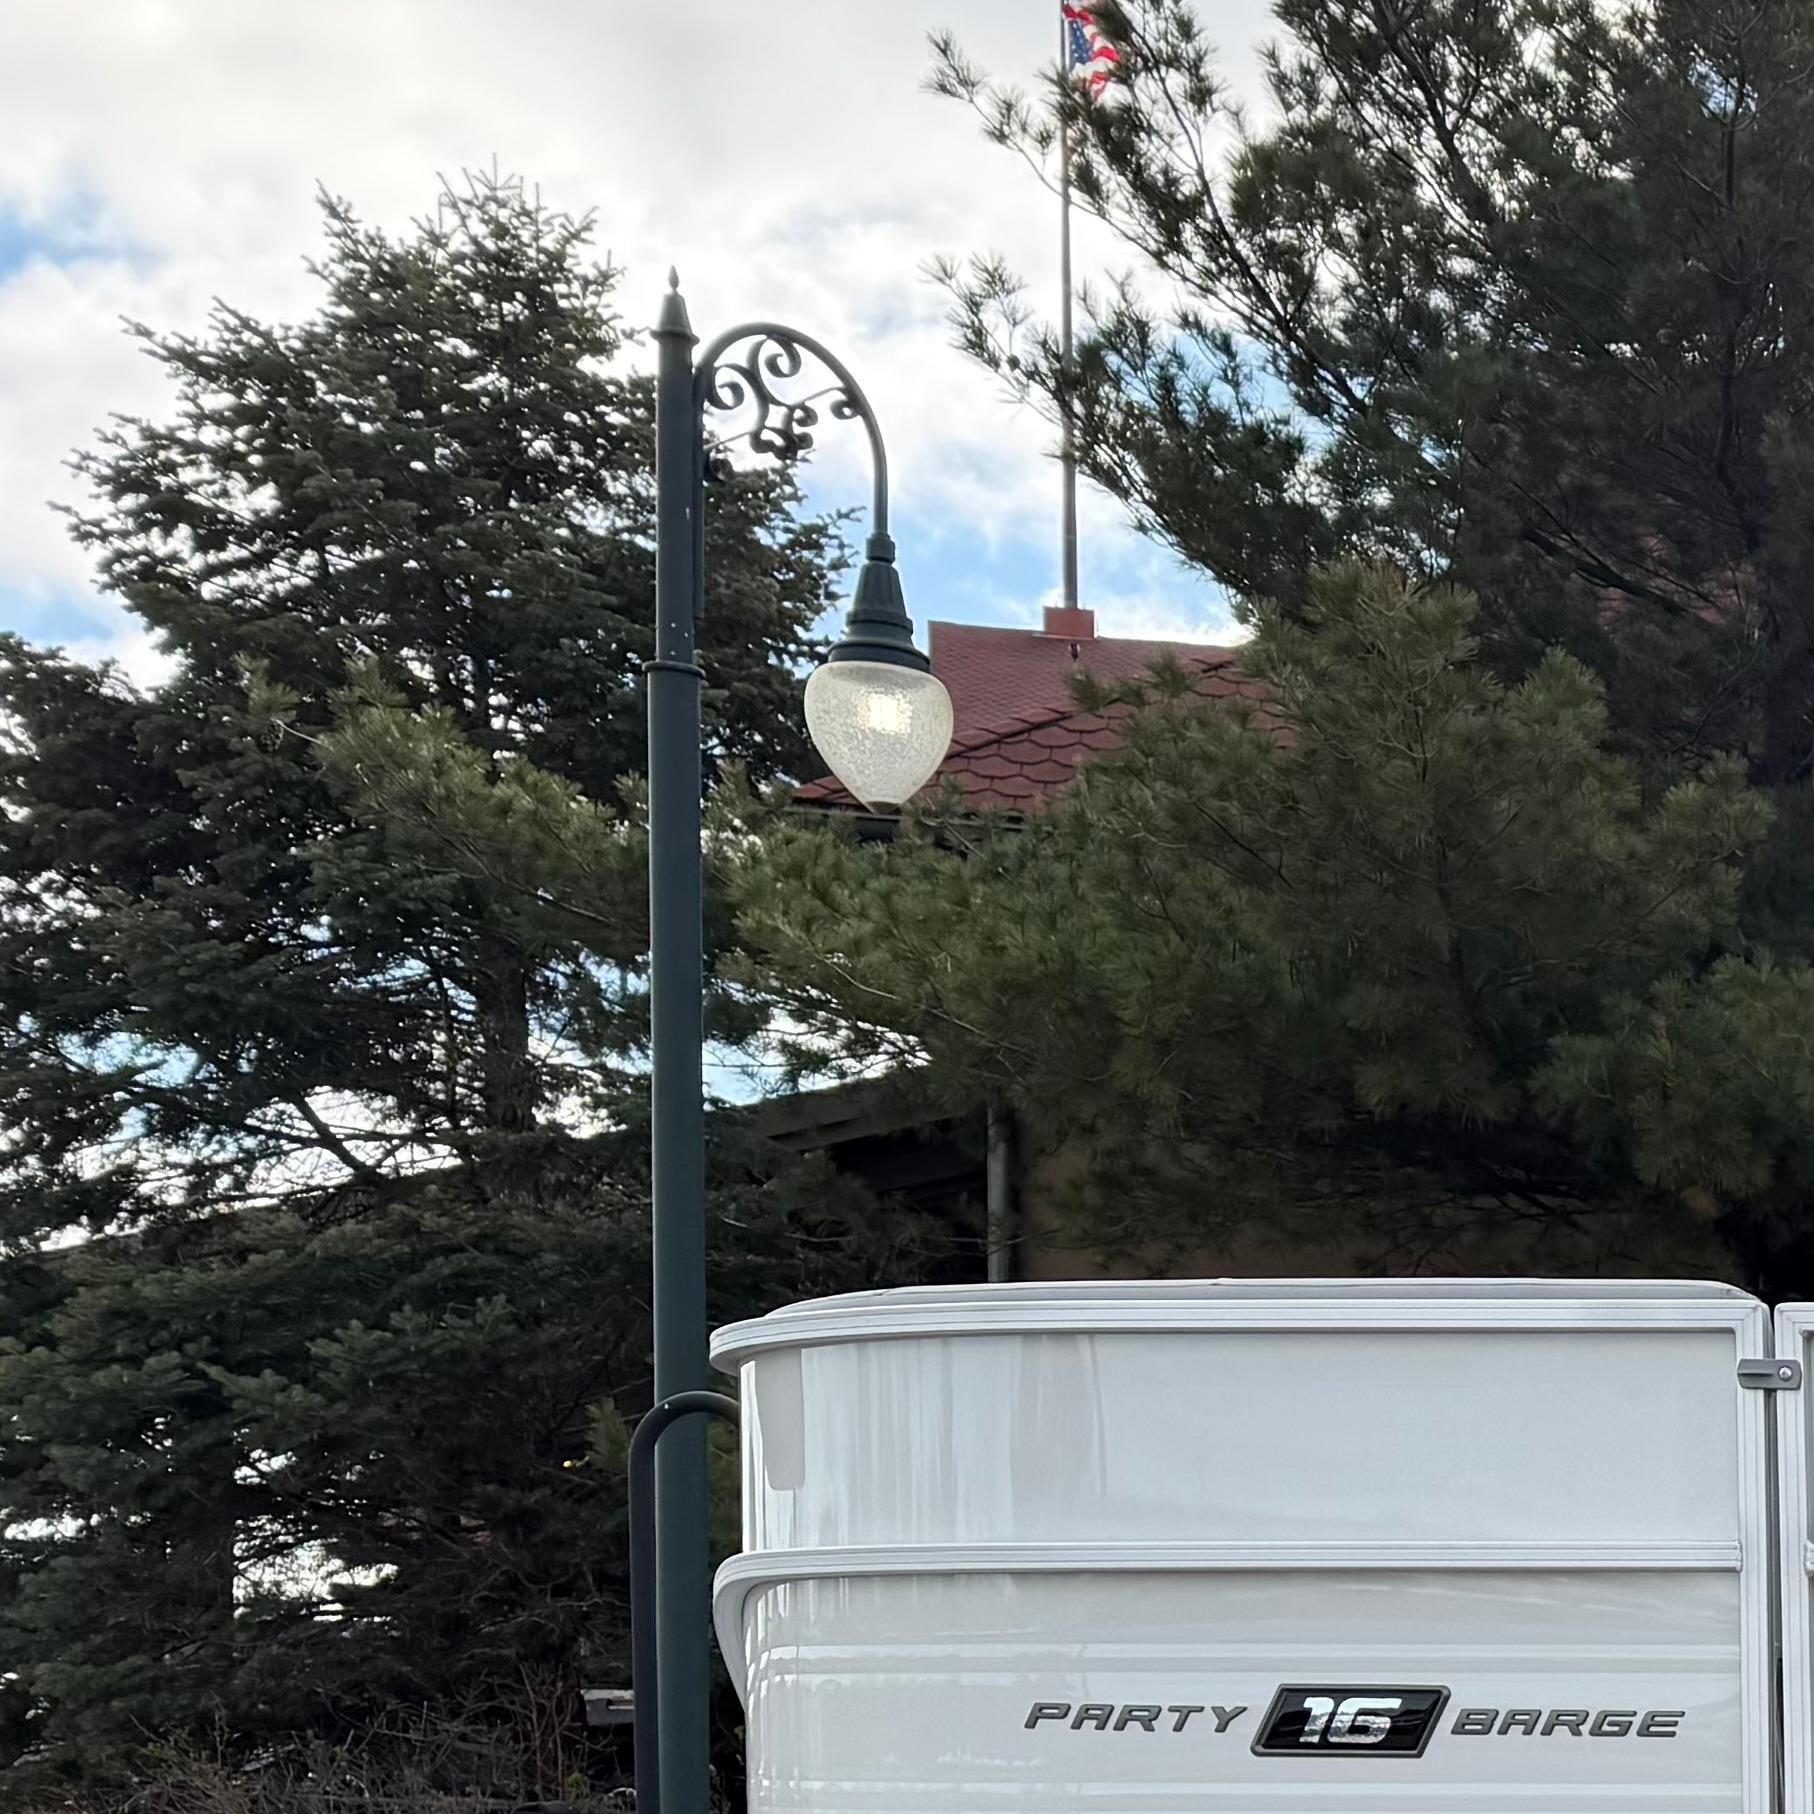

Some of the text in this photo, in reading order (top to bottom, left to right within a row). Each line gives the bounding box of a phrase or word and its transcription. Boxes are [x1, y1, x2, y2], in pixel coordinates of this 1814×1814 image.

[1023, 1695, 1687, 1746] PARTY 16 BARGE
